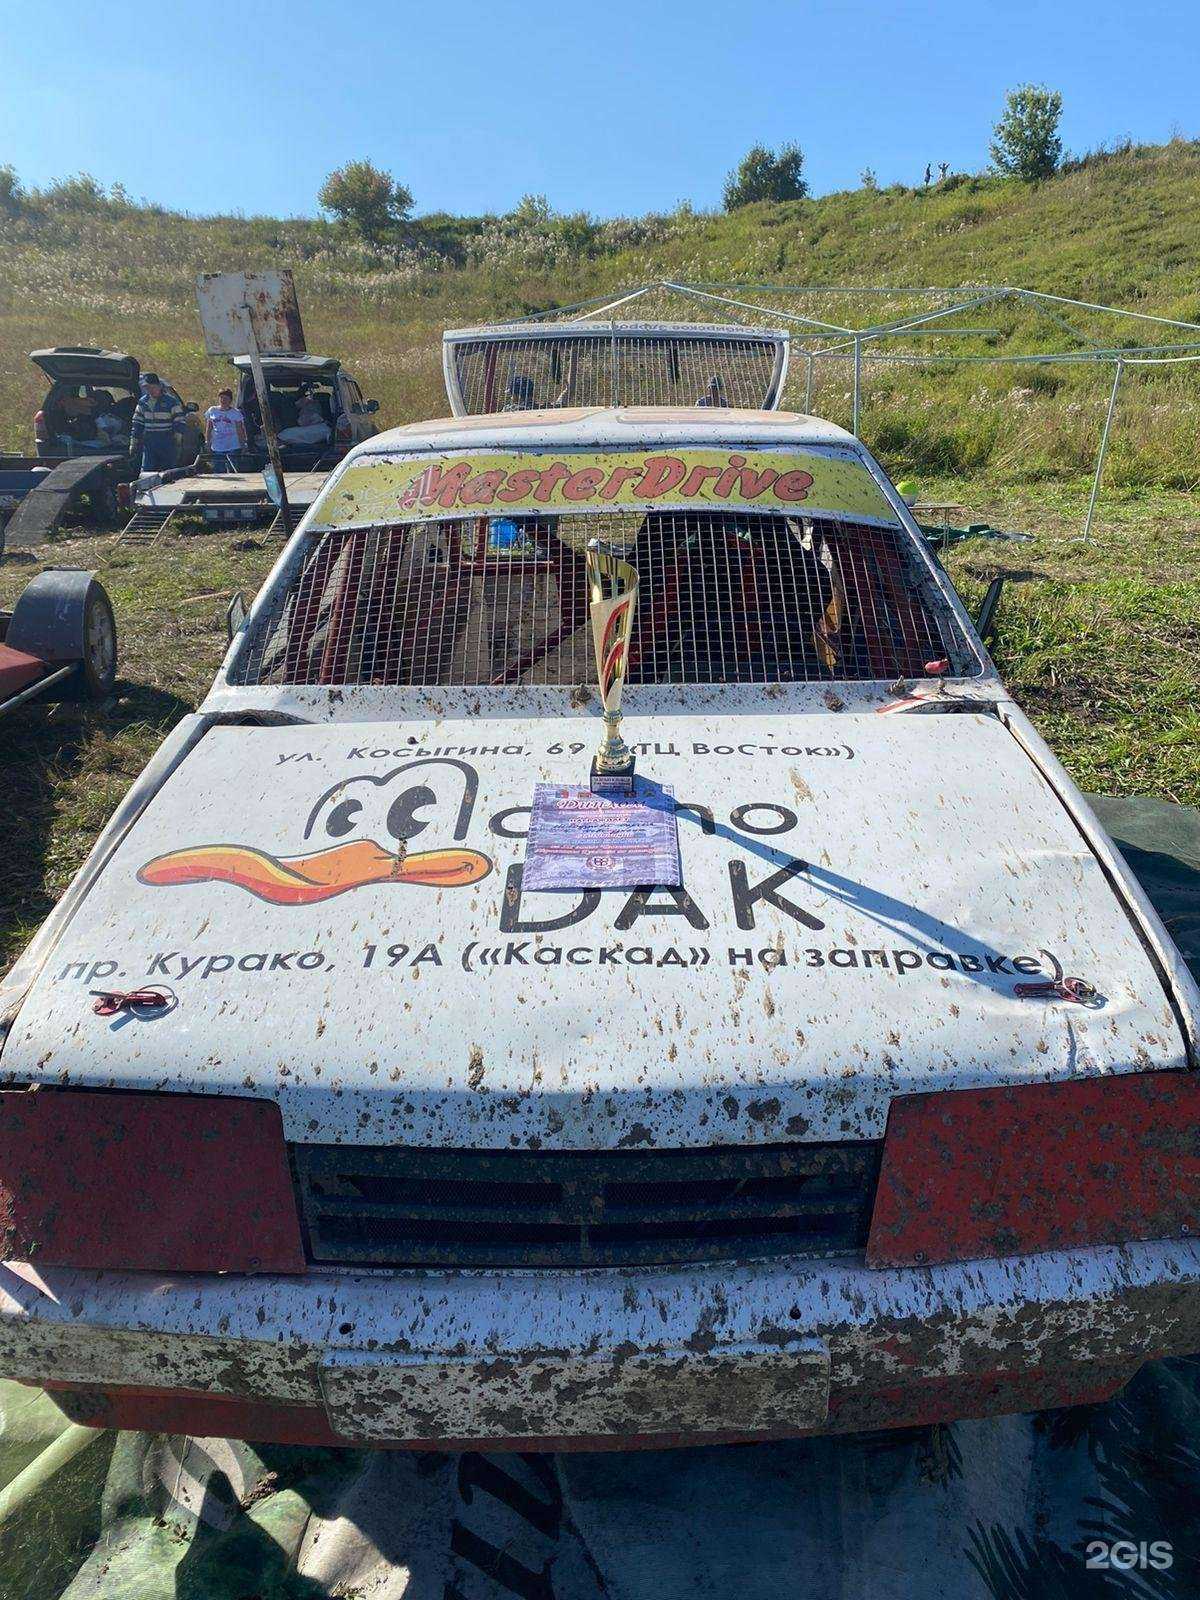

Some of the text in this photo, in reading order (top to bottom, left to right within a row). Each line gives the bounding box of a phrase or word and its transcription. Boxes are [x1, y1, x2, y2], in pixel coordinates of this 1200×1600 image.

[275, 752, 322, 766] ул.
[346, 744, 533, 760] Косыгина,
[546, 742, 586, 755] 69
[56, 941, 1065, 986] пр. Курако, 19А («Каскад» на заправке)
